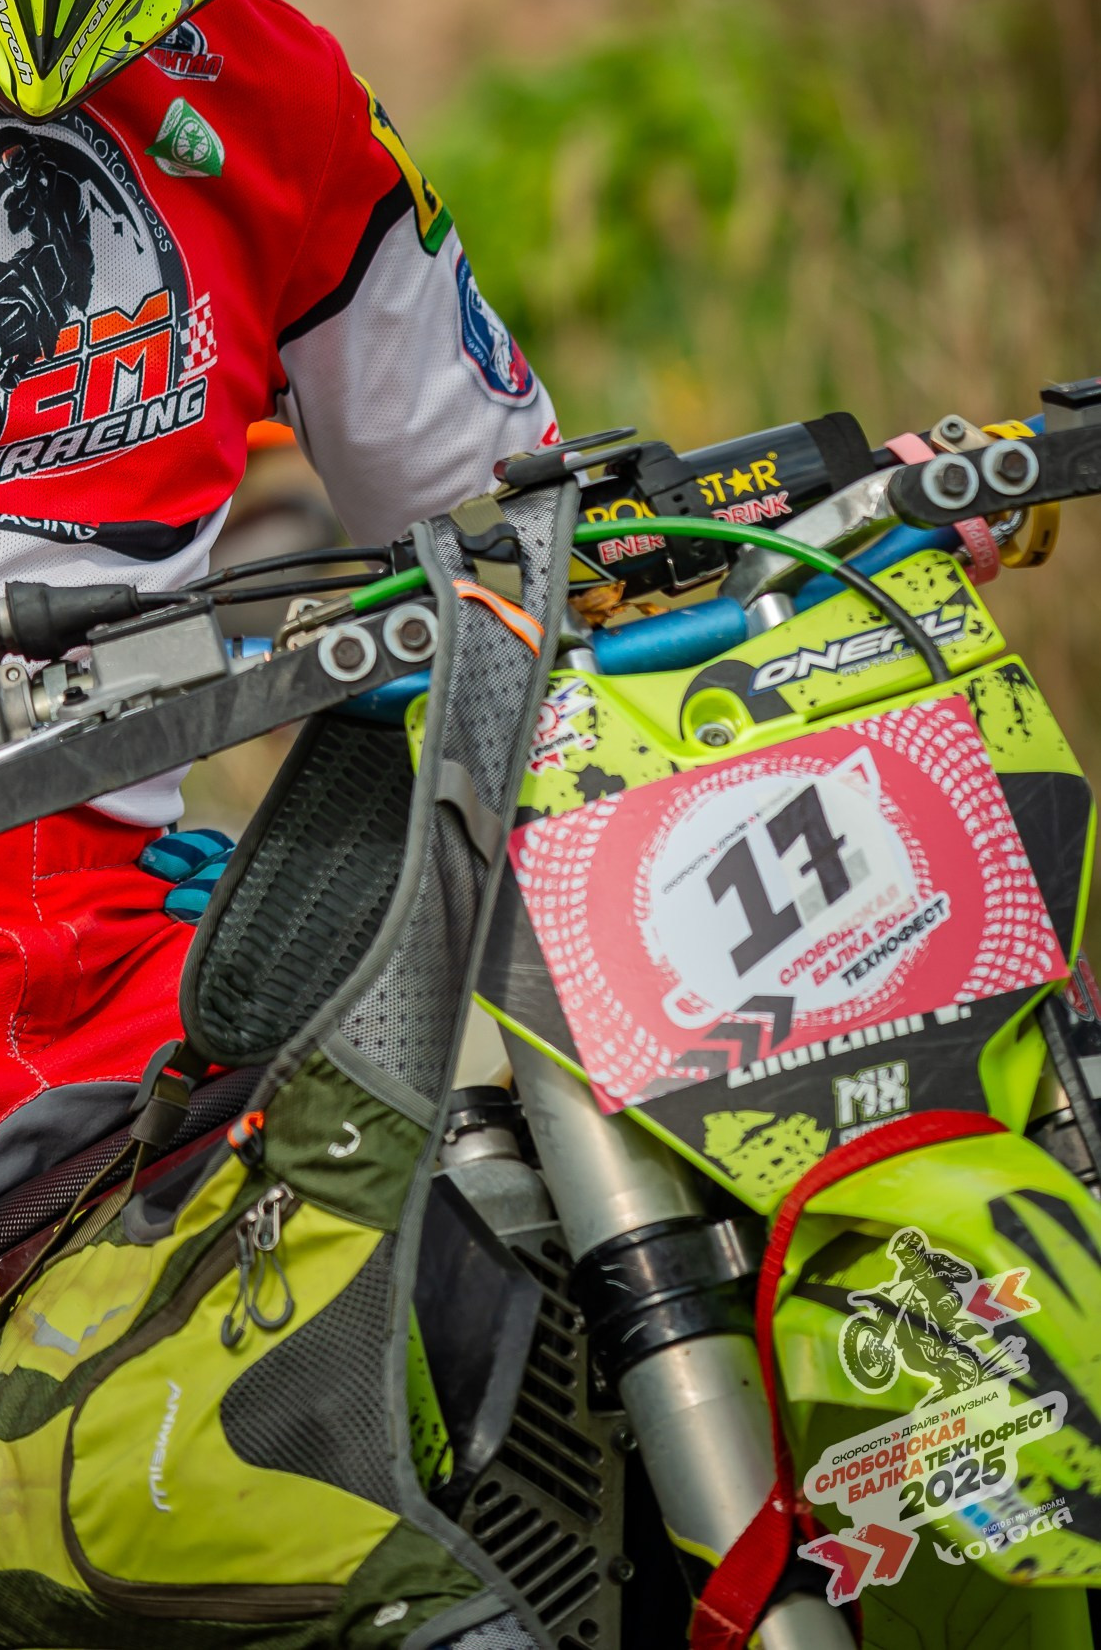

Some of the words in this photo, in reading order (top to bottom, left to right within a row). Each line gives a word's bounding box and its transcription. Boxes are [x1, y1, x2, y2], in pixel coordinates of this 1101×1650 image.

[73, 115, 173, 253] motocross
[705, 783, 848, 977] 17
[812, 932, 874, 987] БАЛКА
[841, 897, 945, 987] ТЕХНОФЕСТ
